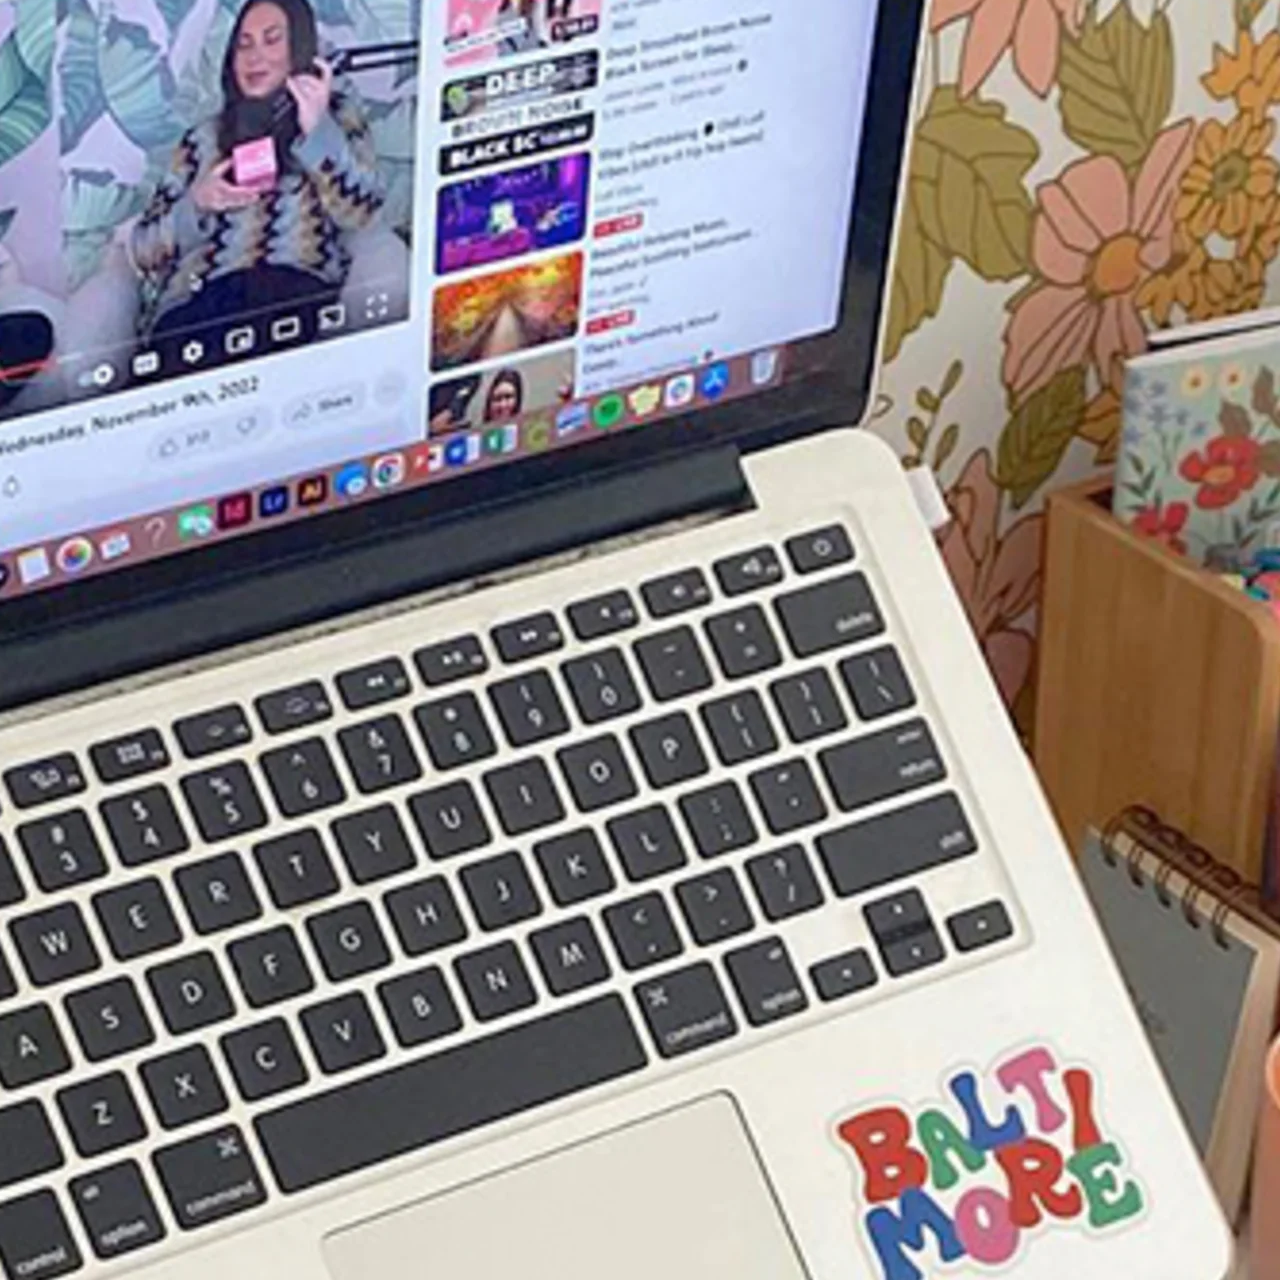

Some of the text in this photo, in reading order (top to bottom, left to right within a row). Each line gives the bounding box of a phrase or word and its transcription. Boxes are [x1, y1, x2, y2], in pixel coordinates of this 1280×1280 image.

[485, 64, 555, 93] DEEP
[449, 140, 507, 168] BLACK
[91, 400, 178, 430] November
[218, 375, 260, 401] 2022
[600, 685, 618, 706] 0
[528, 708, 543, 727] 9
[454, 732, 470, 752] 8
[662, 737, 679, 759] P
[377, 753, 391, 775] 7
[589, 760, 610, 783] O
[303, 780, 318, 799] 6
[519, 785, 532, 804] I
[224, 801, 240, 823] 5
[439, 807, 461, 829] U
[144, 827, 159, 845] 4
[366, 831, 381, 852] Y
[640, 833, 658, 853] L
[59, 851, 78, 872] 3
[289, 855, 304, 876] T
[567, 855, 586, 876] K
[209, 881, 228, 902] R
[497, 879, 510, 902] J
[128, 905, 147, 929] E
[416, 904, 438, 925] H
[41, 931, 68, 955] W
[339, 927, 361, 952] G
[263, 953, 277, 976] F
[560, 943, 584, 966] M
[486, 969, 508, 991] N
[181, 980, 203, 1004] D
[761, 987, 801, 1011] option
[412, 995, 431, 1017] B
[101, 1007, 120, 1029] S
[333, 1020, 351, 1041] V
[665, 1014, 727, 1045] command
[20, 1034, 38, 1057] A
[255, 1046, 276, 1070] C
[174, 1074, 196, 1097] X
[92, 1101, 112, 1125] Z
[185, 1180, 256, 1217] command
[101, 1219, 149, 1247] option
[17, 1247, 67, 1276] control
